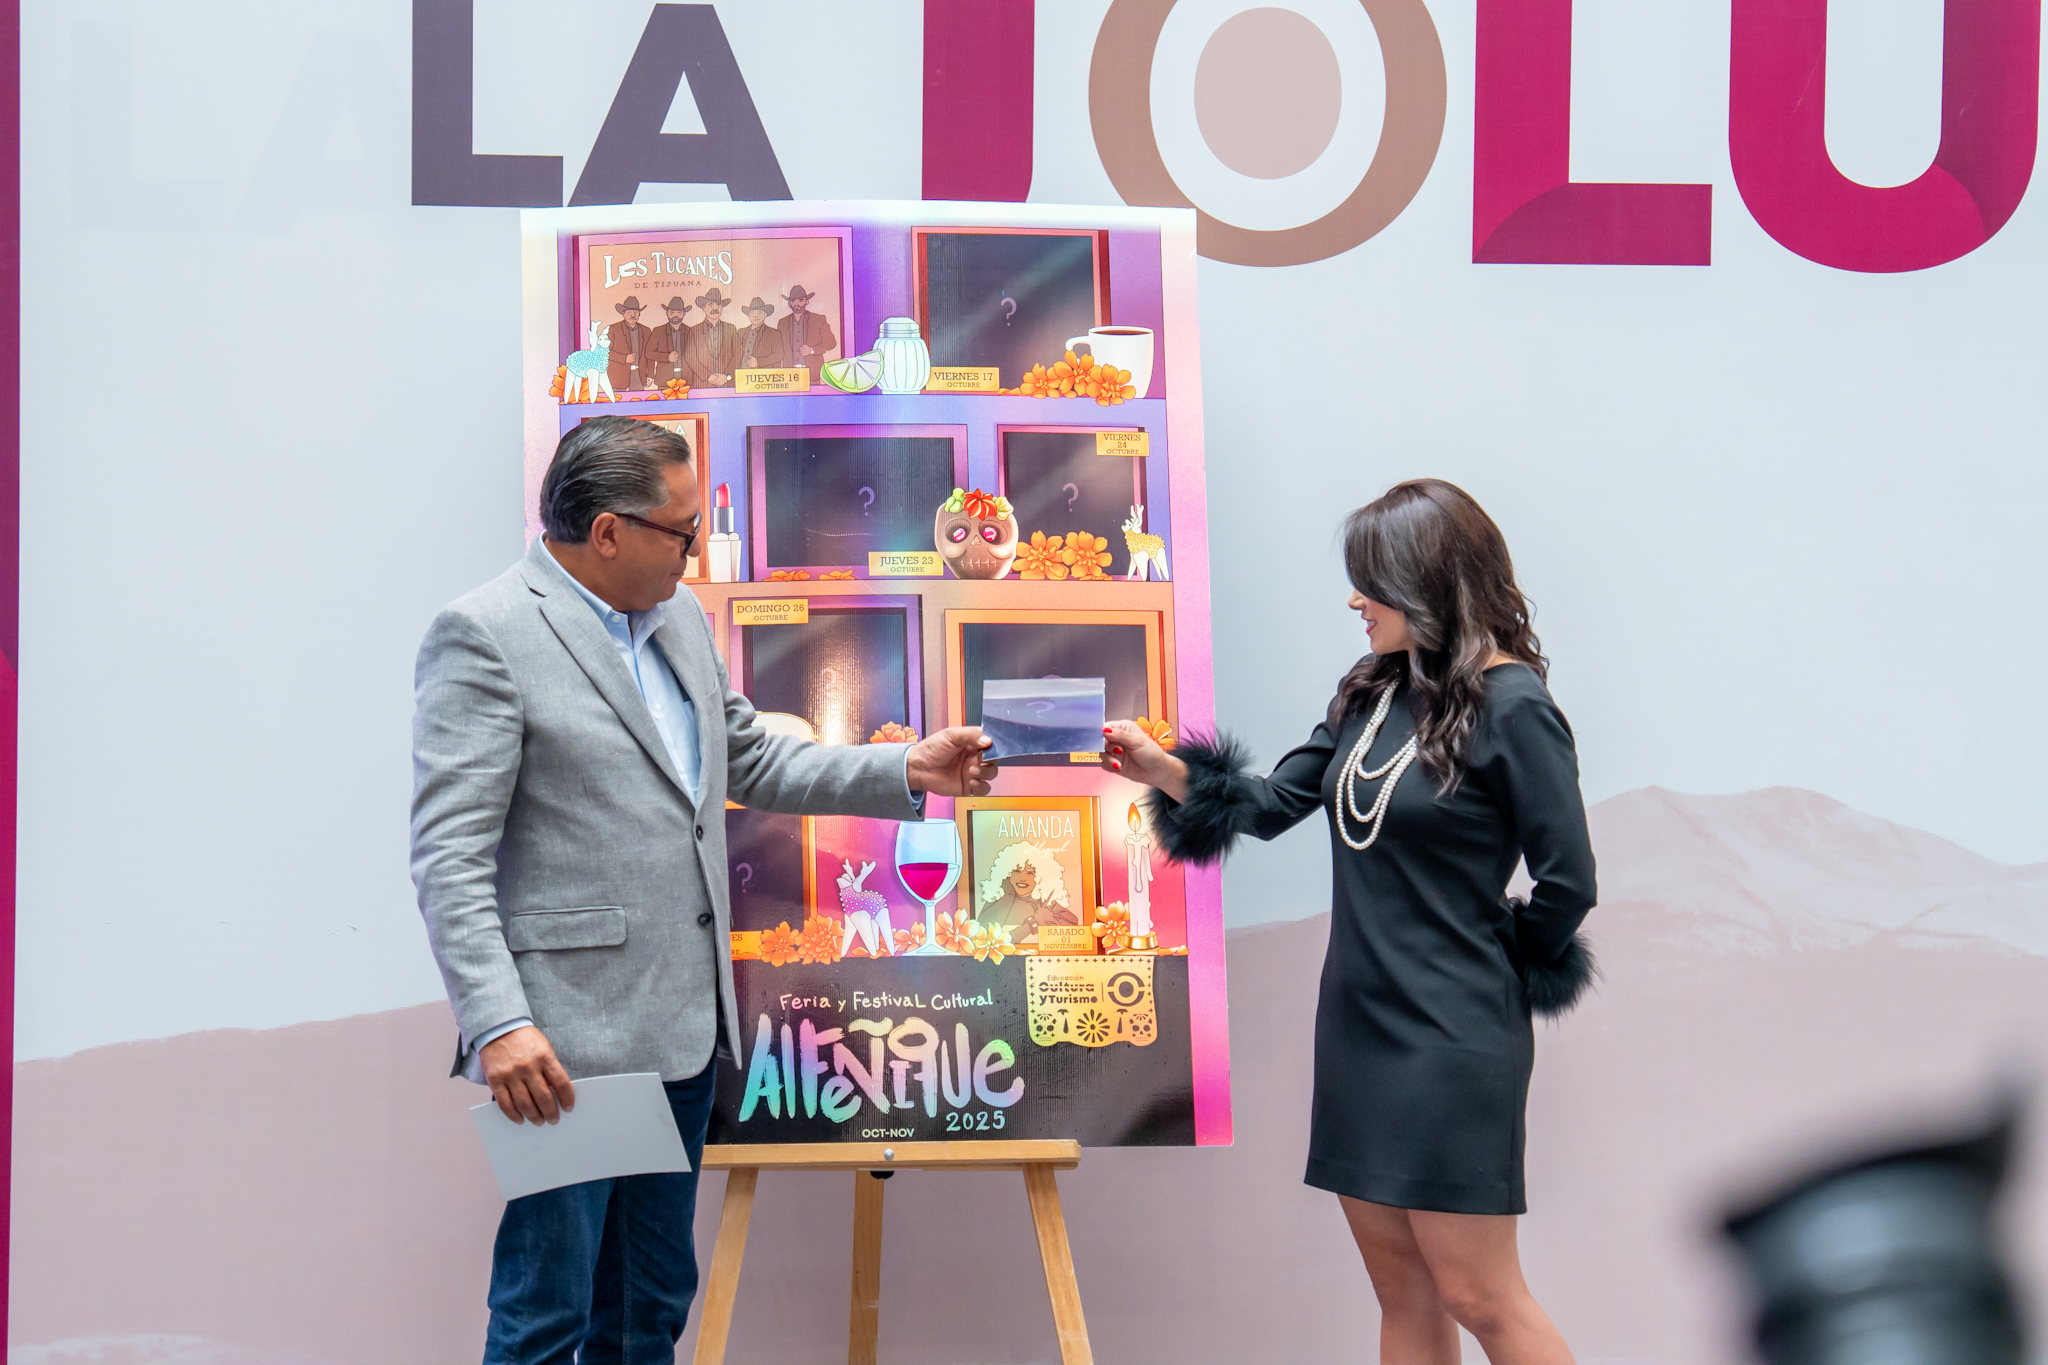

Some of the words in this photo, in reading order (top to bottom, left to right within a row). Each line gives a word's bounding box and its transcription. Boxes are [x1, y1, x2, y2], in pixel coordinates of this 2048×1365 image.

[411, 0, 794, 209] LA
[651, 251, 733, 285] TUCANES
[654, 280, 702, 288] TIJUANA
[745, 374, 786, 385] JUEVES
[789, 373, 800, 383] 16
[934, 372, 979, 381] VIERNES
[982, 372, 993, 381] 17
[755, 382, 790, 390] OCTUBRE
[1103, 433, 1141, 441] VIERNES
[1117, 441, 1127, 449] 24
[880, 556, 919, 566] JUEVES
[921, 556, 934, 565] 23
[737, 604, 790, 614] DOMINGO
[793, 604, 805, 612] 26
[998, 816, 1074, 838] AMANDA
[1047, 928, 1085, 936] SÁBADO
[1039, 982, 1094, 992] Cultura
[779, 994, 831, 1010] Feria
[838, 1000, 847, 1012] y
[931, 989, 994, 1010] Cultural
[946, 1110, 1006, 1131] 2025
[862, 1128, 915, 1138] OCT-NOV
